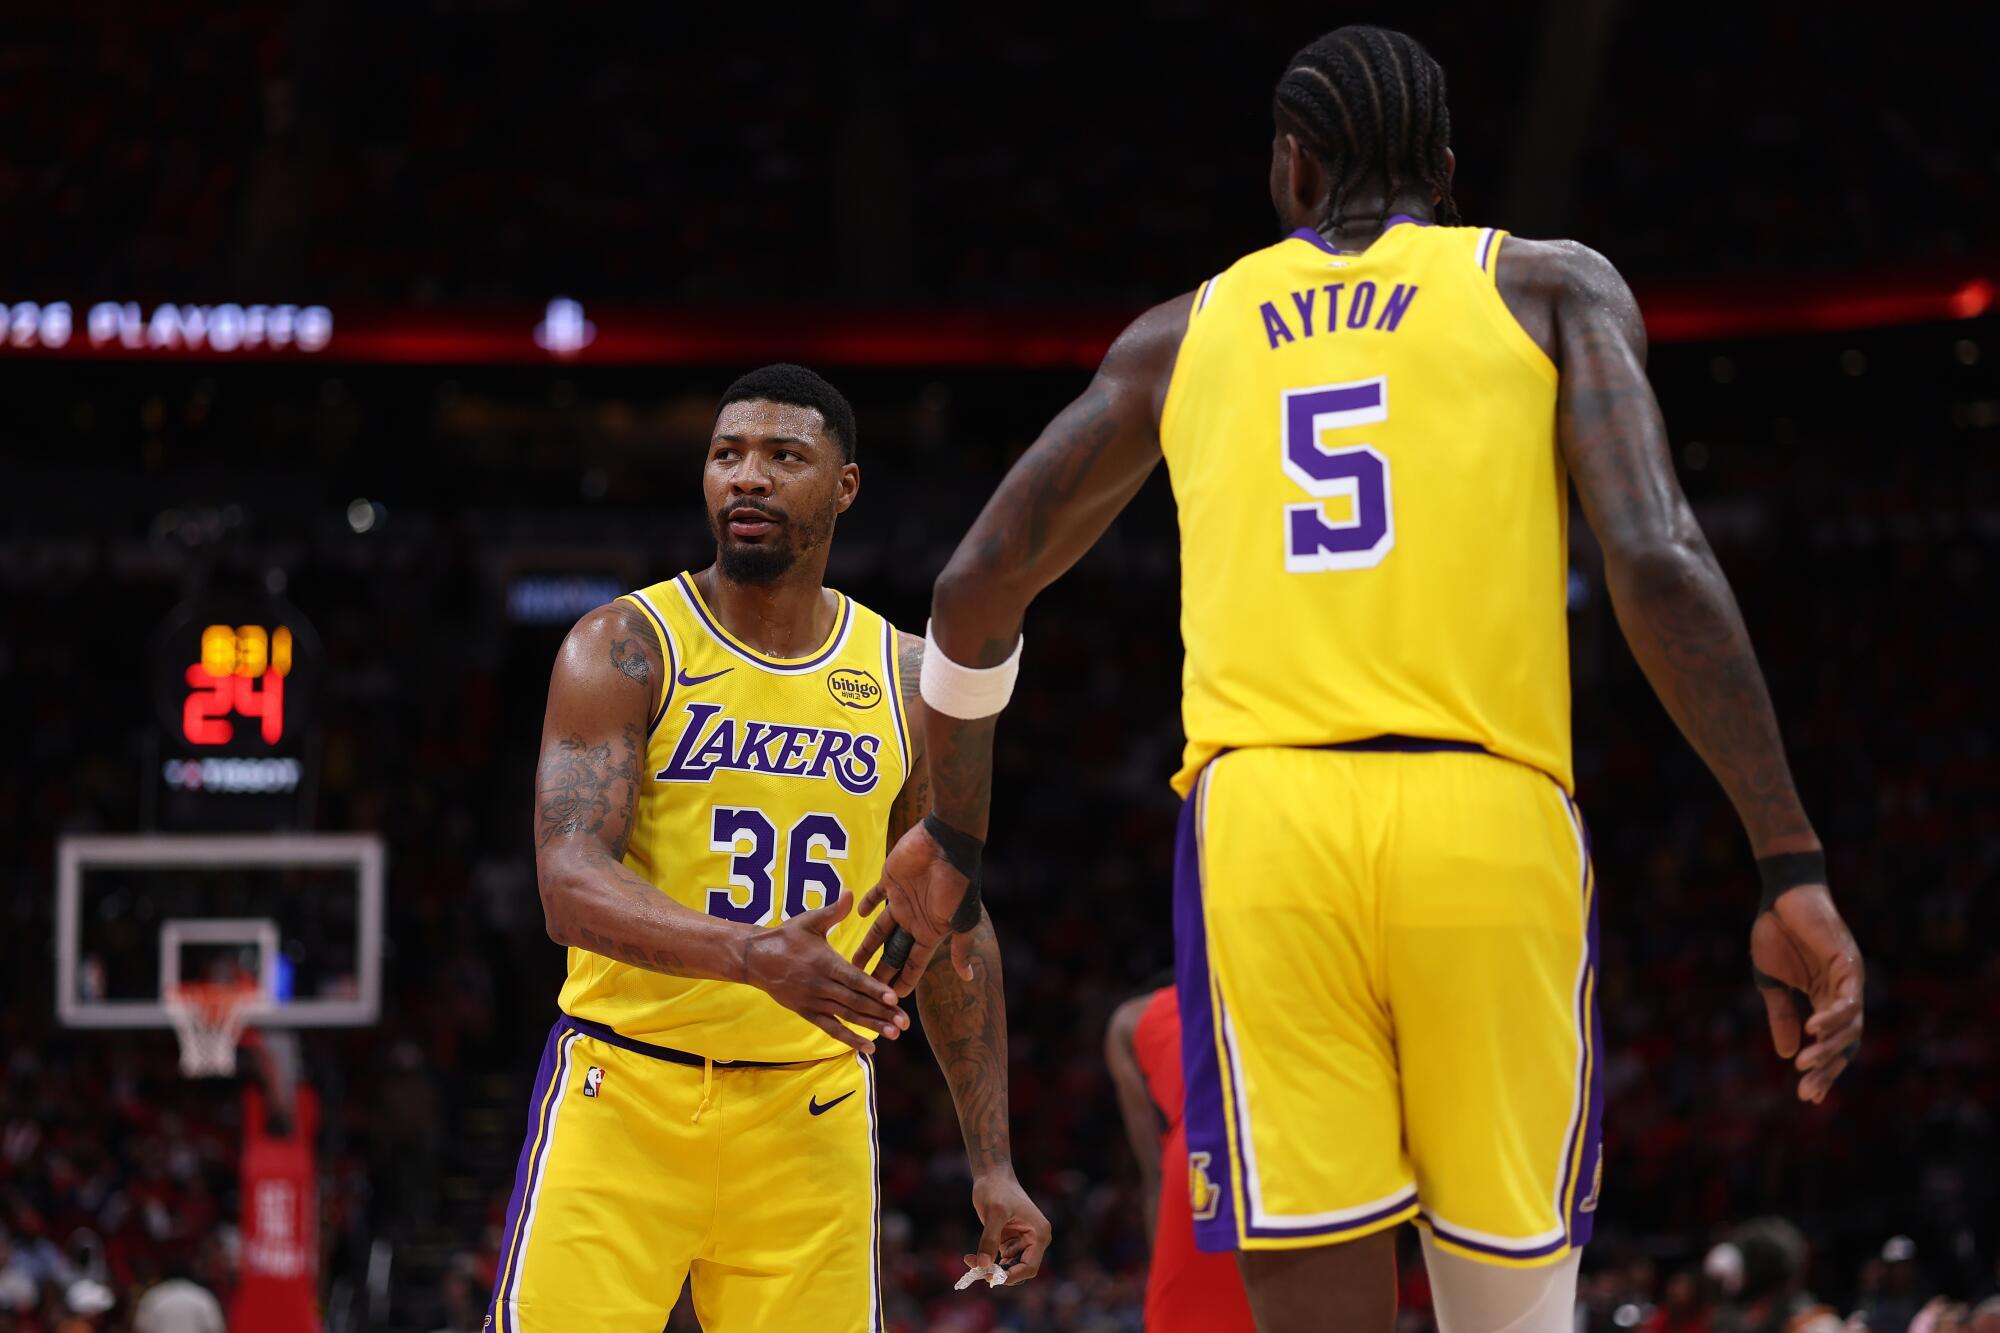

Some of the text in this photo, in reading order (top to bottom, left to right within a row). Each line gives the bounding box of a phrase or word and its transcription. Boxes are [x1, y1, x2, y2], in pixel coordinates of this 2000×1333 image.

[0, 301, 333, 352] 26 PLAYOFFS
[1259, 281, 1418, 350] AYTON
[1280, 375, 1395, 574] 5
[183, 663, 284, 745] 24
[831, 678, 878, 698] bibigo
[654, 702, 881, 796] LAKERS
[705, 804, 849, 928] 36
